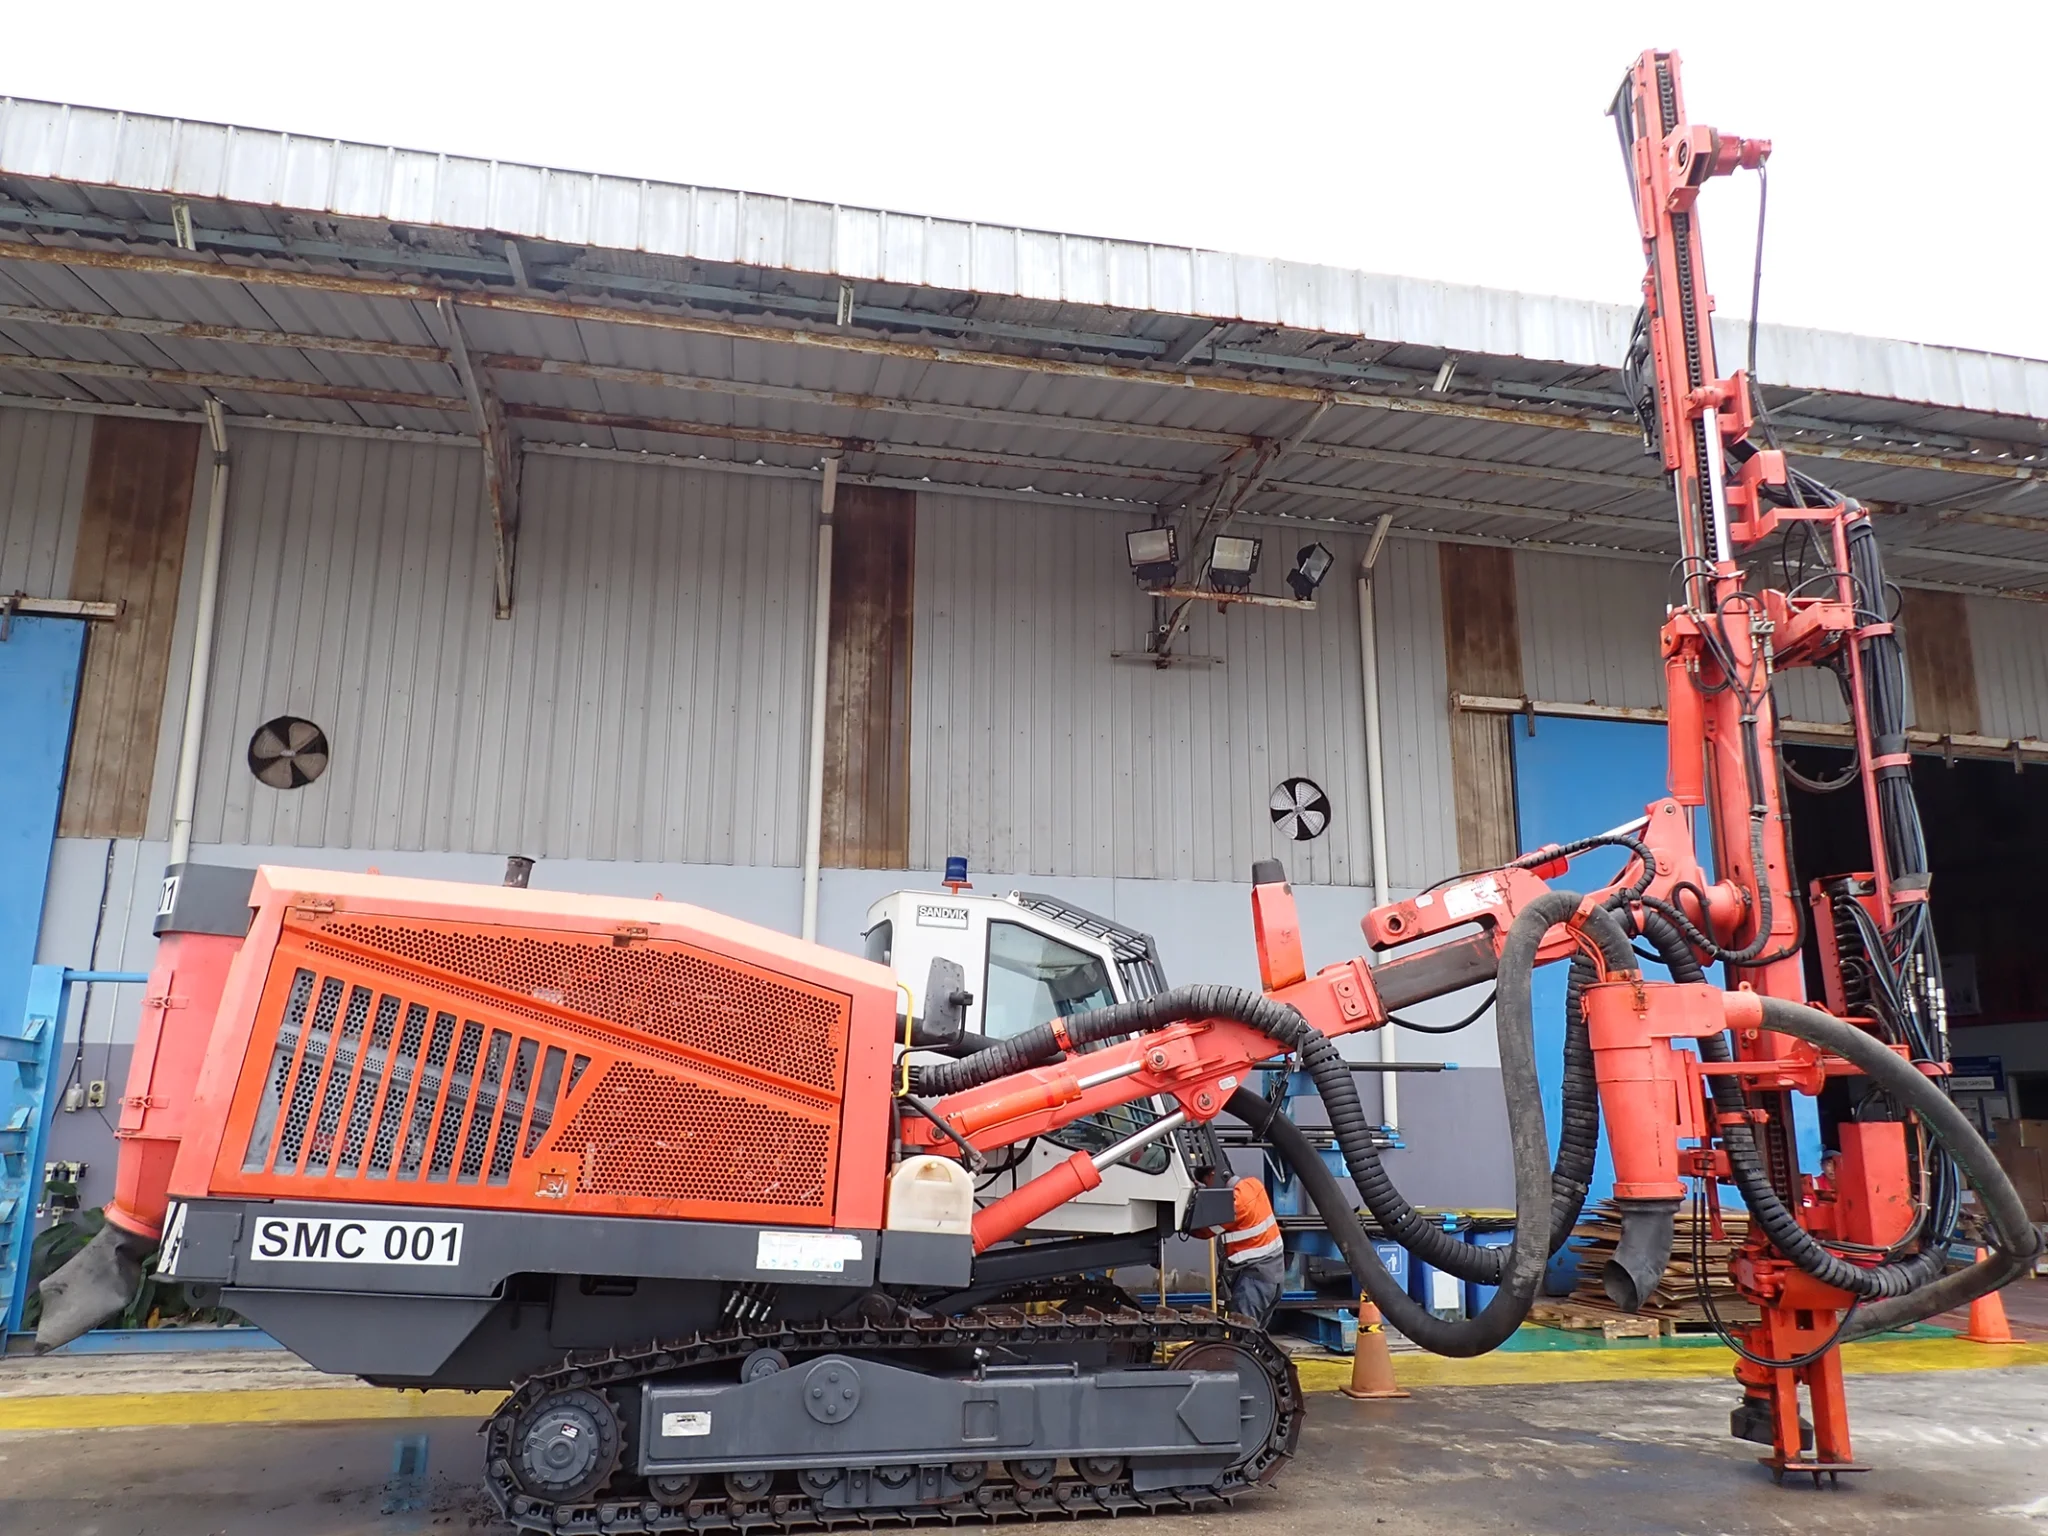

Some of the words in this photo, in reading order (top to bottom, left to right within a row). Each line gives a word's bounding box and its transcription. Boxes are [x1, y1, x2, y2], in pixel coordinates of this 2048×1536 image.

[919, 906, 967, 920] SANDVIK
[259, 1221, 367, 1259] SMC
[384, 1225, 458, 1262] 001
